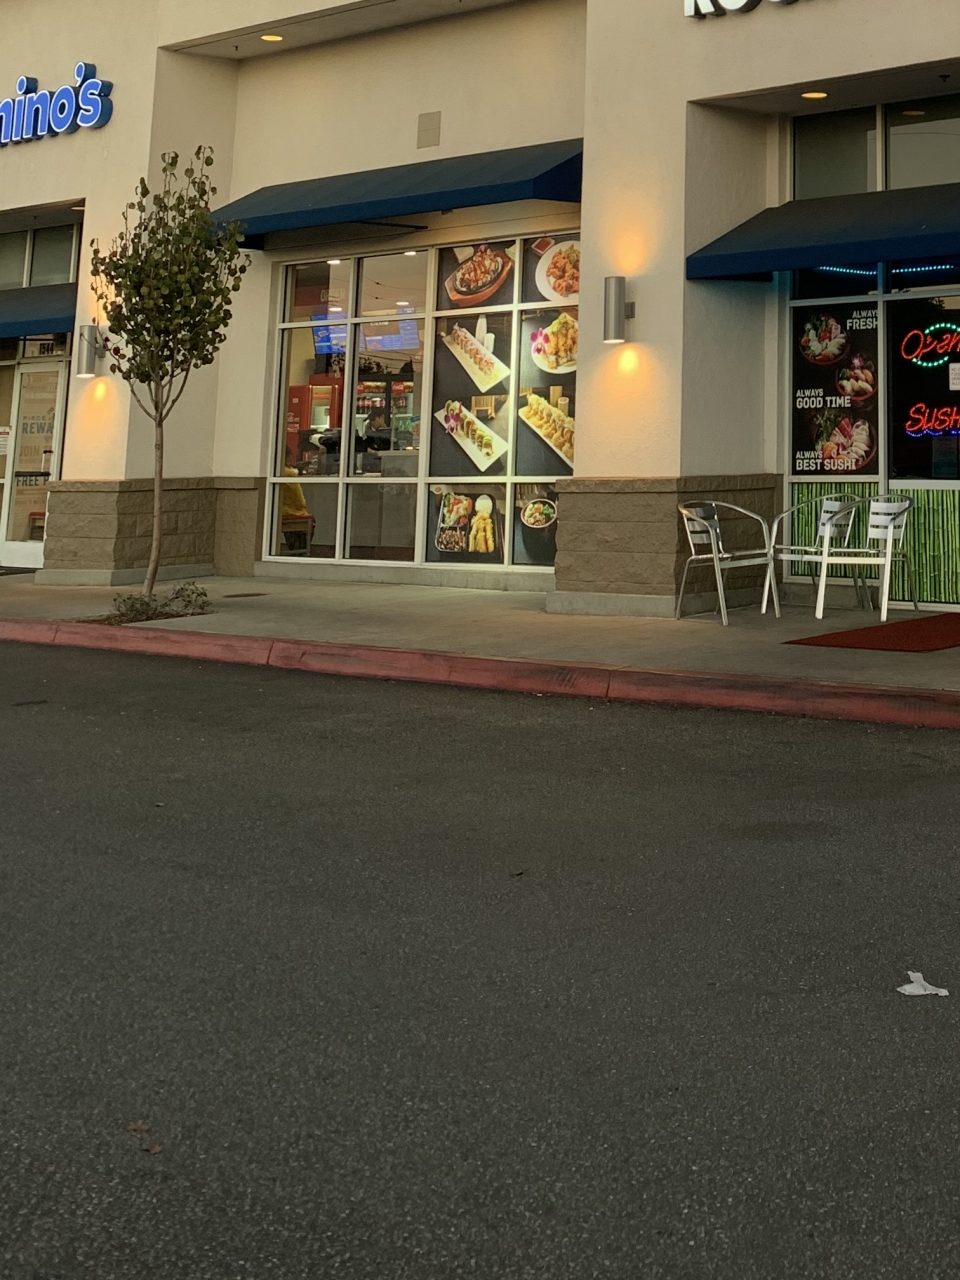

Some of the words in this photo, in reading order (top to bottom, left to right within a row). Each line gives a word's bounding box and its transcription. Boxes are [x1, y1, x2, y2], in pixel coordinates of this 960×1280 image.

[796, 388, 824, 398] ALWAYS
[796, 397, 824, 409] GOOD
[825, 396, 851, 408] TIME
[796, 450, 823, 459] ALWAYS
[796, 459, 822, 471] BEST
[824, 458, 857, 470] SUSHI
